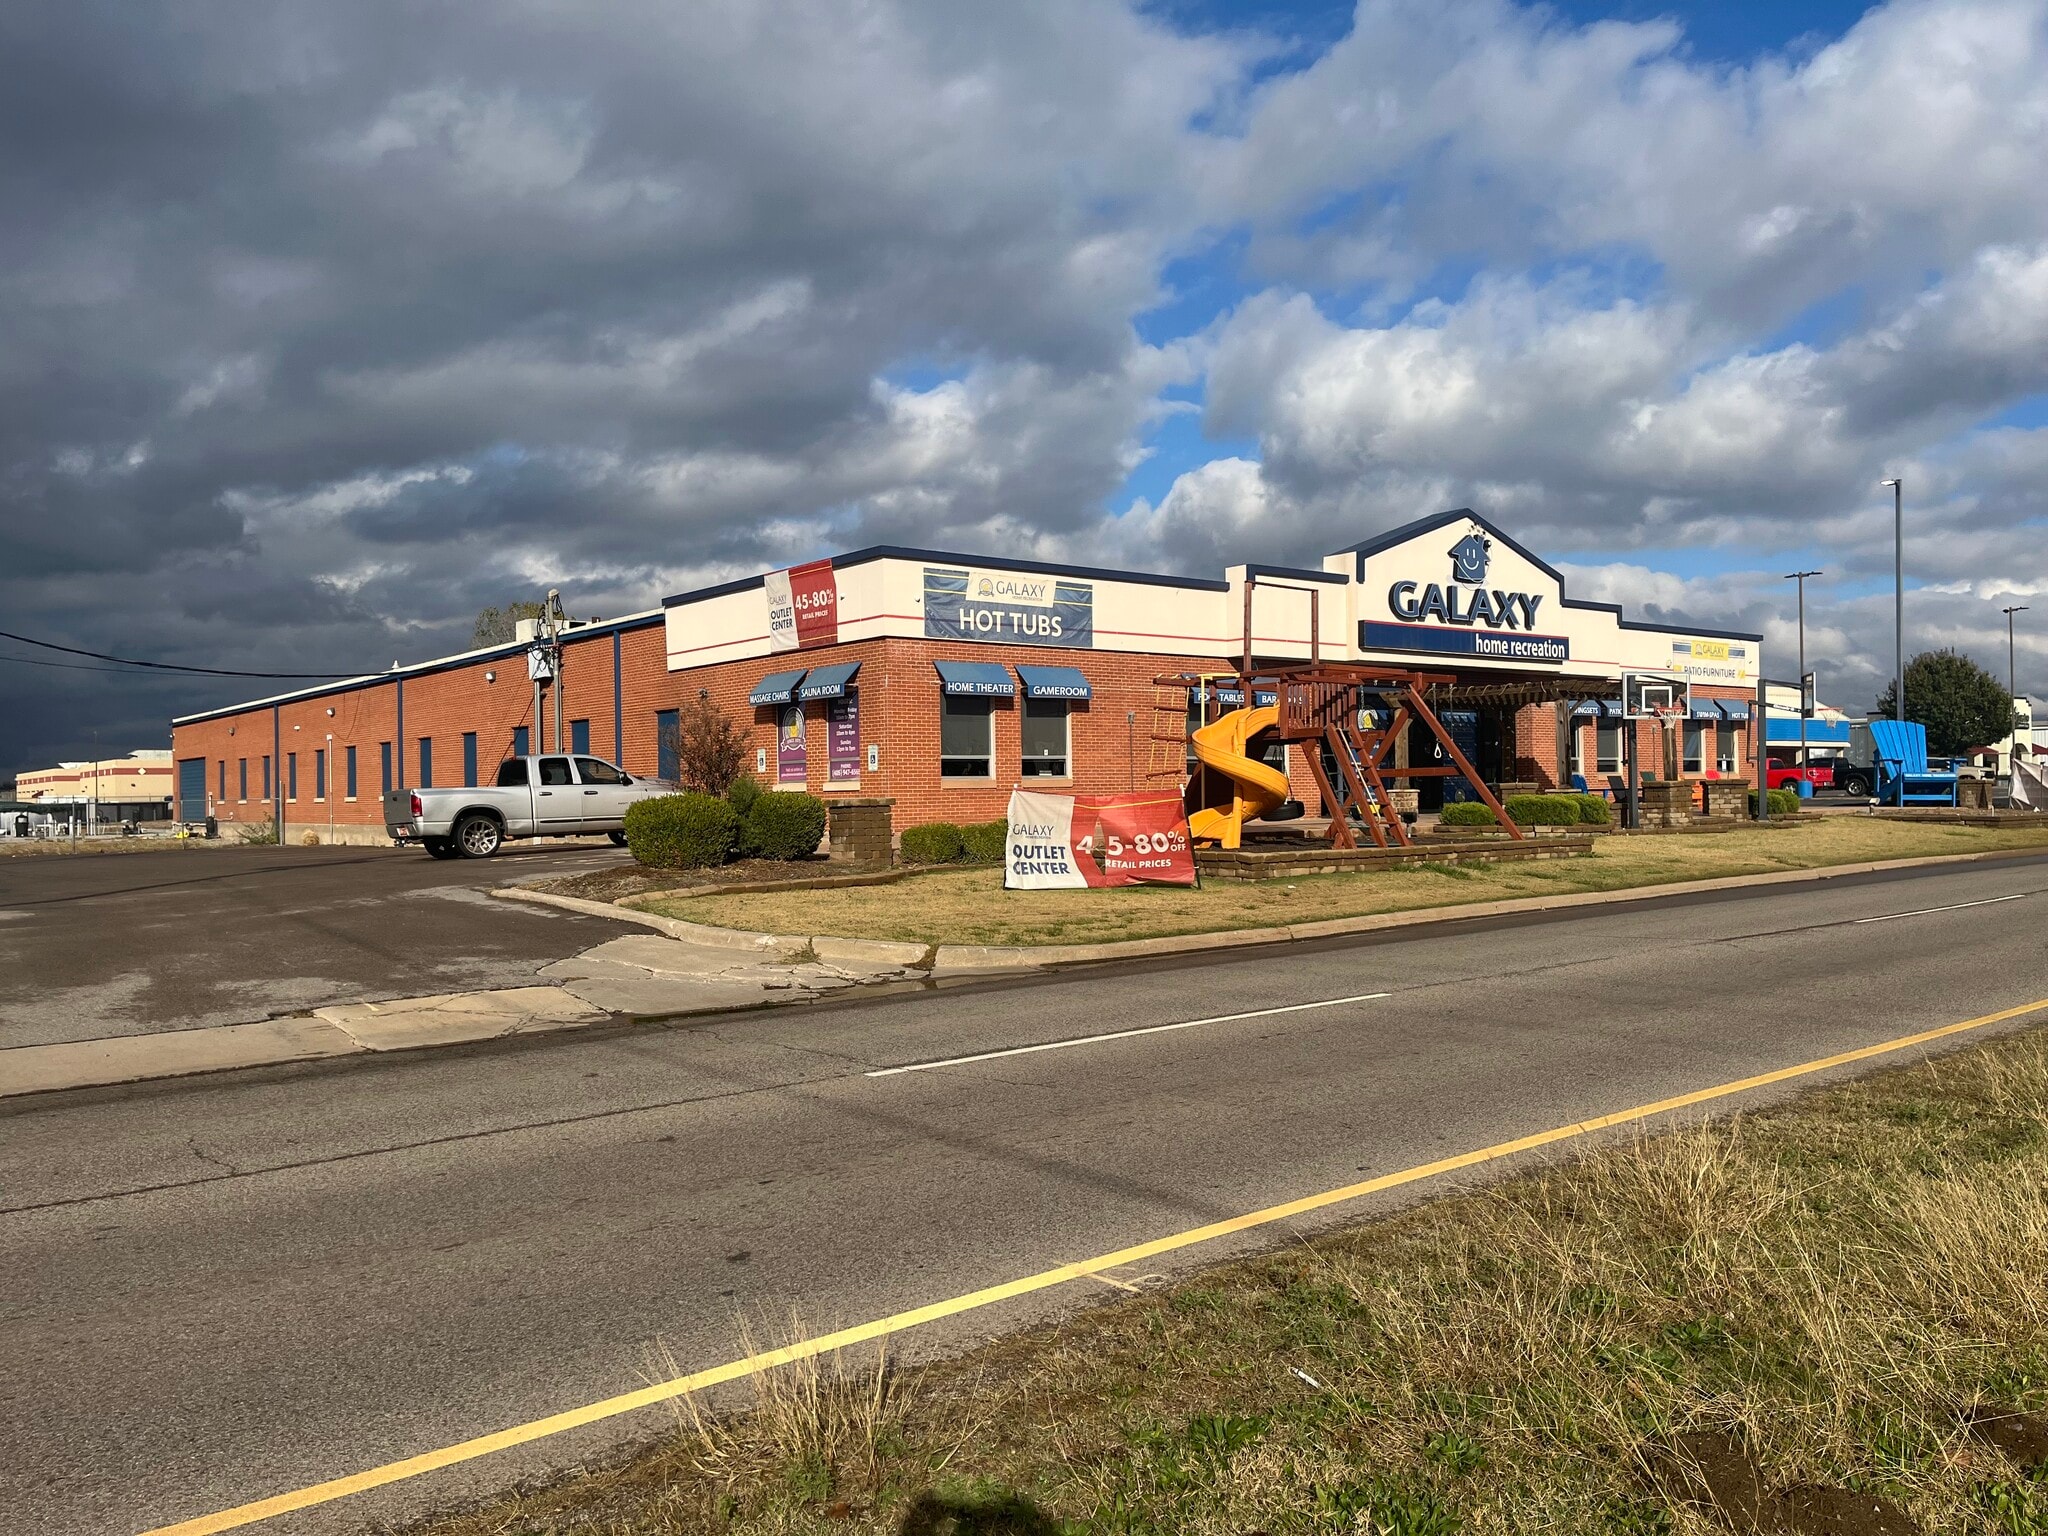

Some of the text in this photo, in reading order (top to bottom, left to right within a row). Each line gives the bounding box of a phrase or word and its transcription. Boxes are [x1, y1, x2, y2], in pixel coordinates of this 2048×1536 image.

[996, 580, 1046, 597] GALAXY
[1388, 580, 1543, 631] GALAXY
[771, 606, 792, 620] OUTLET
[771, 618, 793, 631] CENTER
[959, 608, 1062, 637] HOT TUBS
[1476, 633, 1565, 658] home recreation
[1684, 666, 1736, 678] PATIO FURNITURE
[801, 684, 841, 697] SAUNA ROOM
[947, 682, 1014, 694] HOME THEATER
[1033, 685, 1088, 697] GAMEROOM
[749, 690, 790, 704] MASSAGE CHAIRS
[1262, 695, 1277, 704] BAR
[1012, 823, 1054, 836] GALAXY
[1012, 844, 1066, 859] OUTLET
[1012, 860, 1070, 875] CENTER
[1105, 859, 1172, 869] RETAIL PRICES
